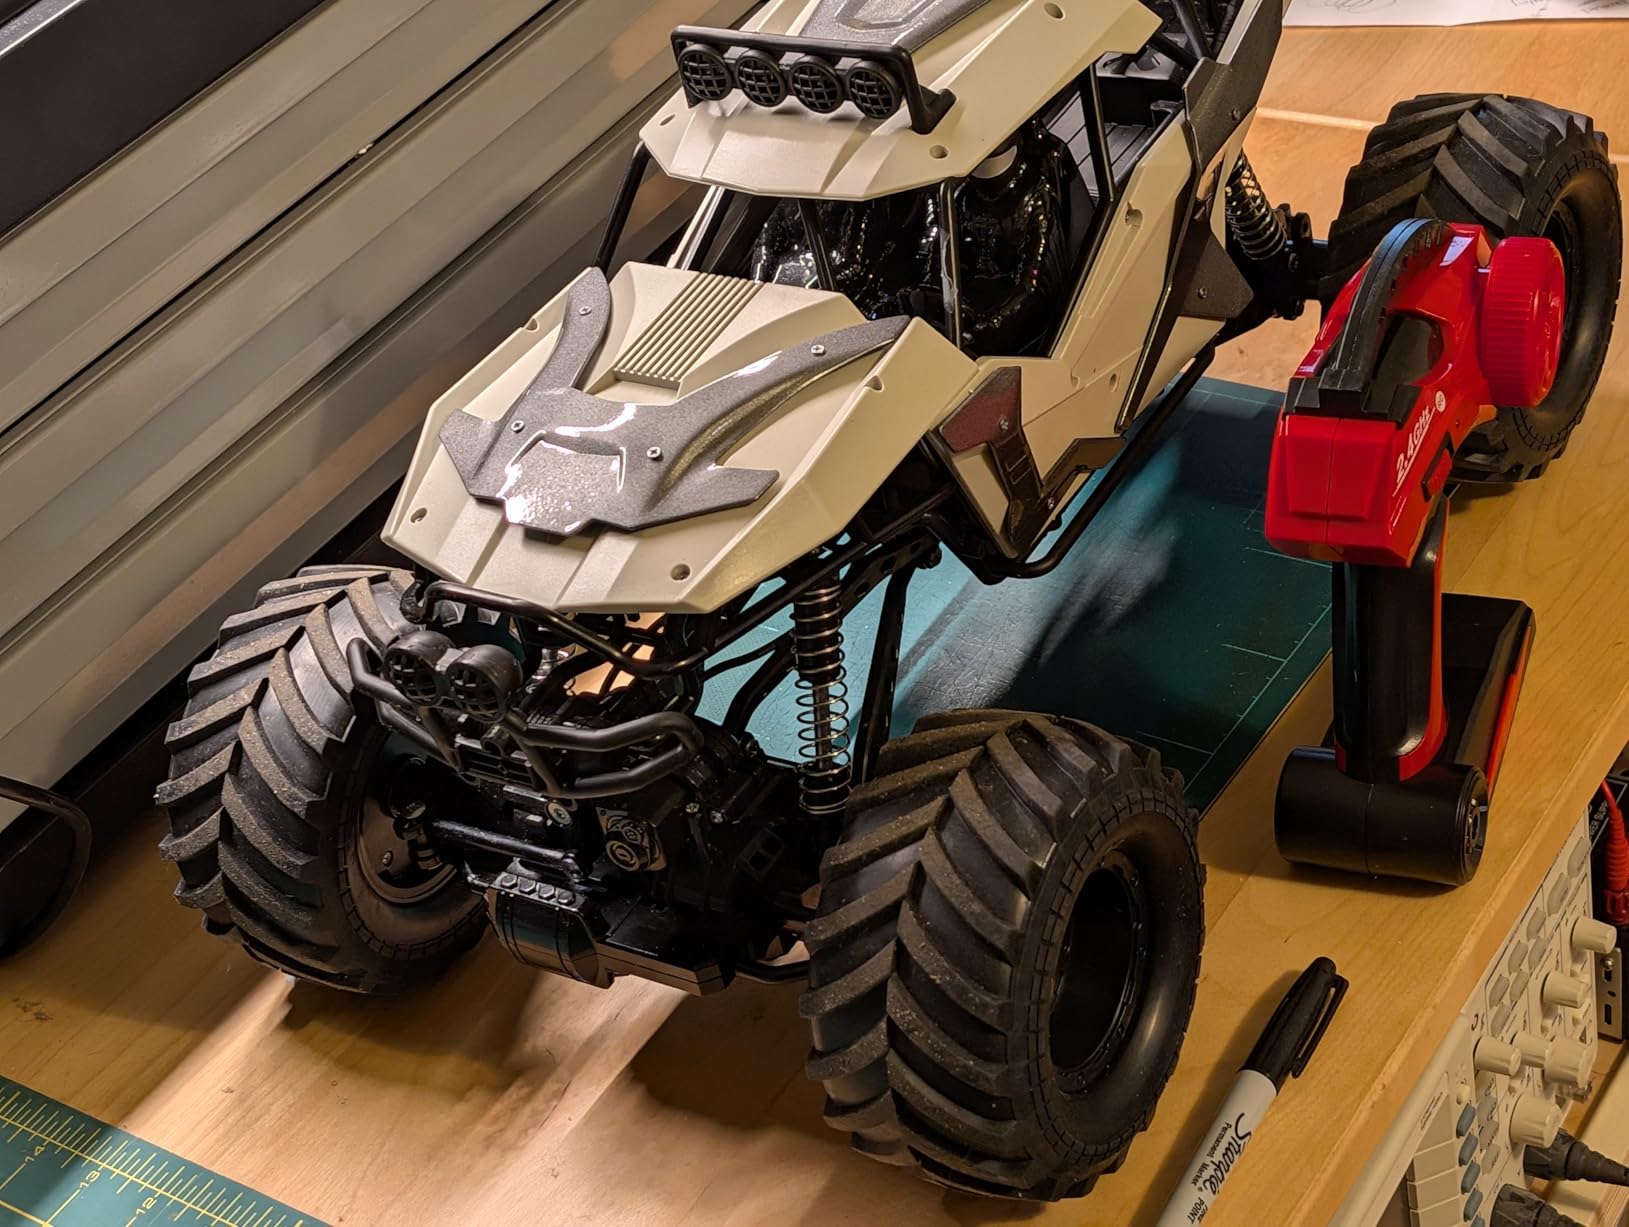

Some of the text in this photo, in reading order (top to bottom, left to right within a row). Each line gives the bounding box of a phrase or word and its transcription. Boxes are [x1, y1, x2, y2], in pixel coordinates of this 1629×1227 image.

[1396, 405, 1431, 484] 2.4GHz
[25, 1144, 45, 1163] 14
[1191, 1122, 1232, 1186] Permanent Marker
[79, 1170, 100, 1189] 13
[135, 1196, 158, 1216] 12
[1187, 1196, 1205, 1224] POINT
